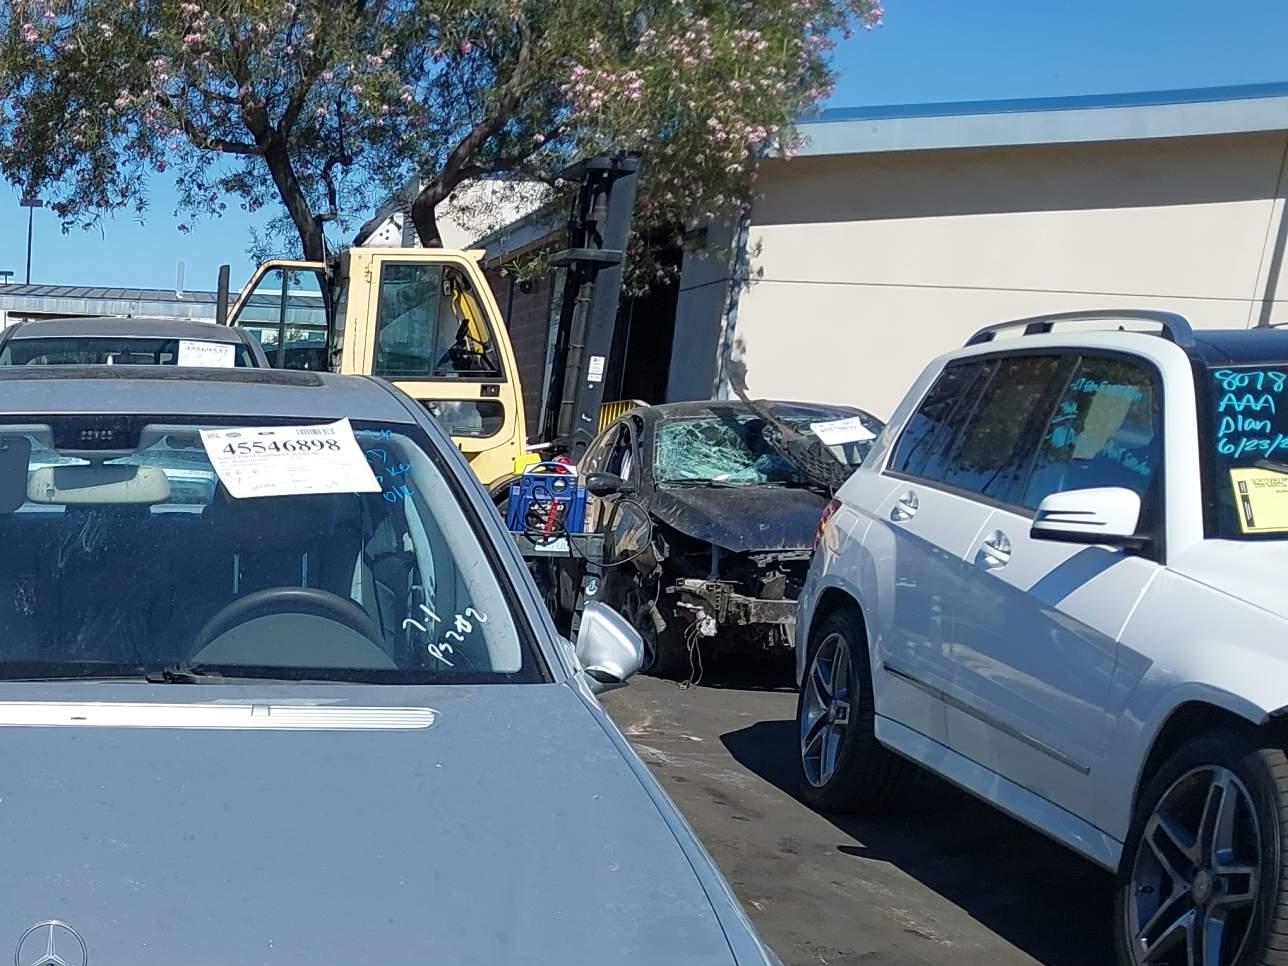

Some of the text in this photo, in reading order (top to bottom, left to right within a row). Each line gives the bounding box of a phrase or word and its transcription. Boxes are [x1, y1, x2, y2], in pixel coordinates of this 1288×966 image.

[1215, 369, 1287, 392] 8078
[1218, 393, 1275, 414] AAA
[223, 438, 341, 456] 45546898
